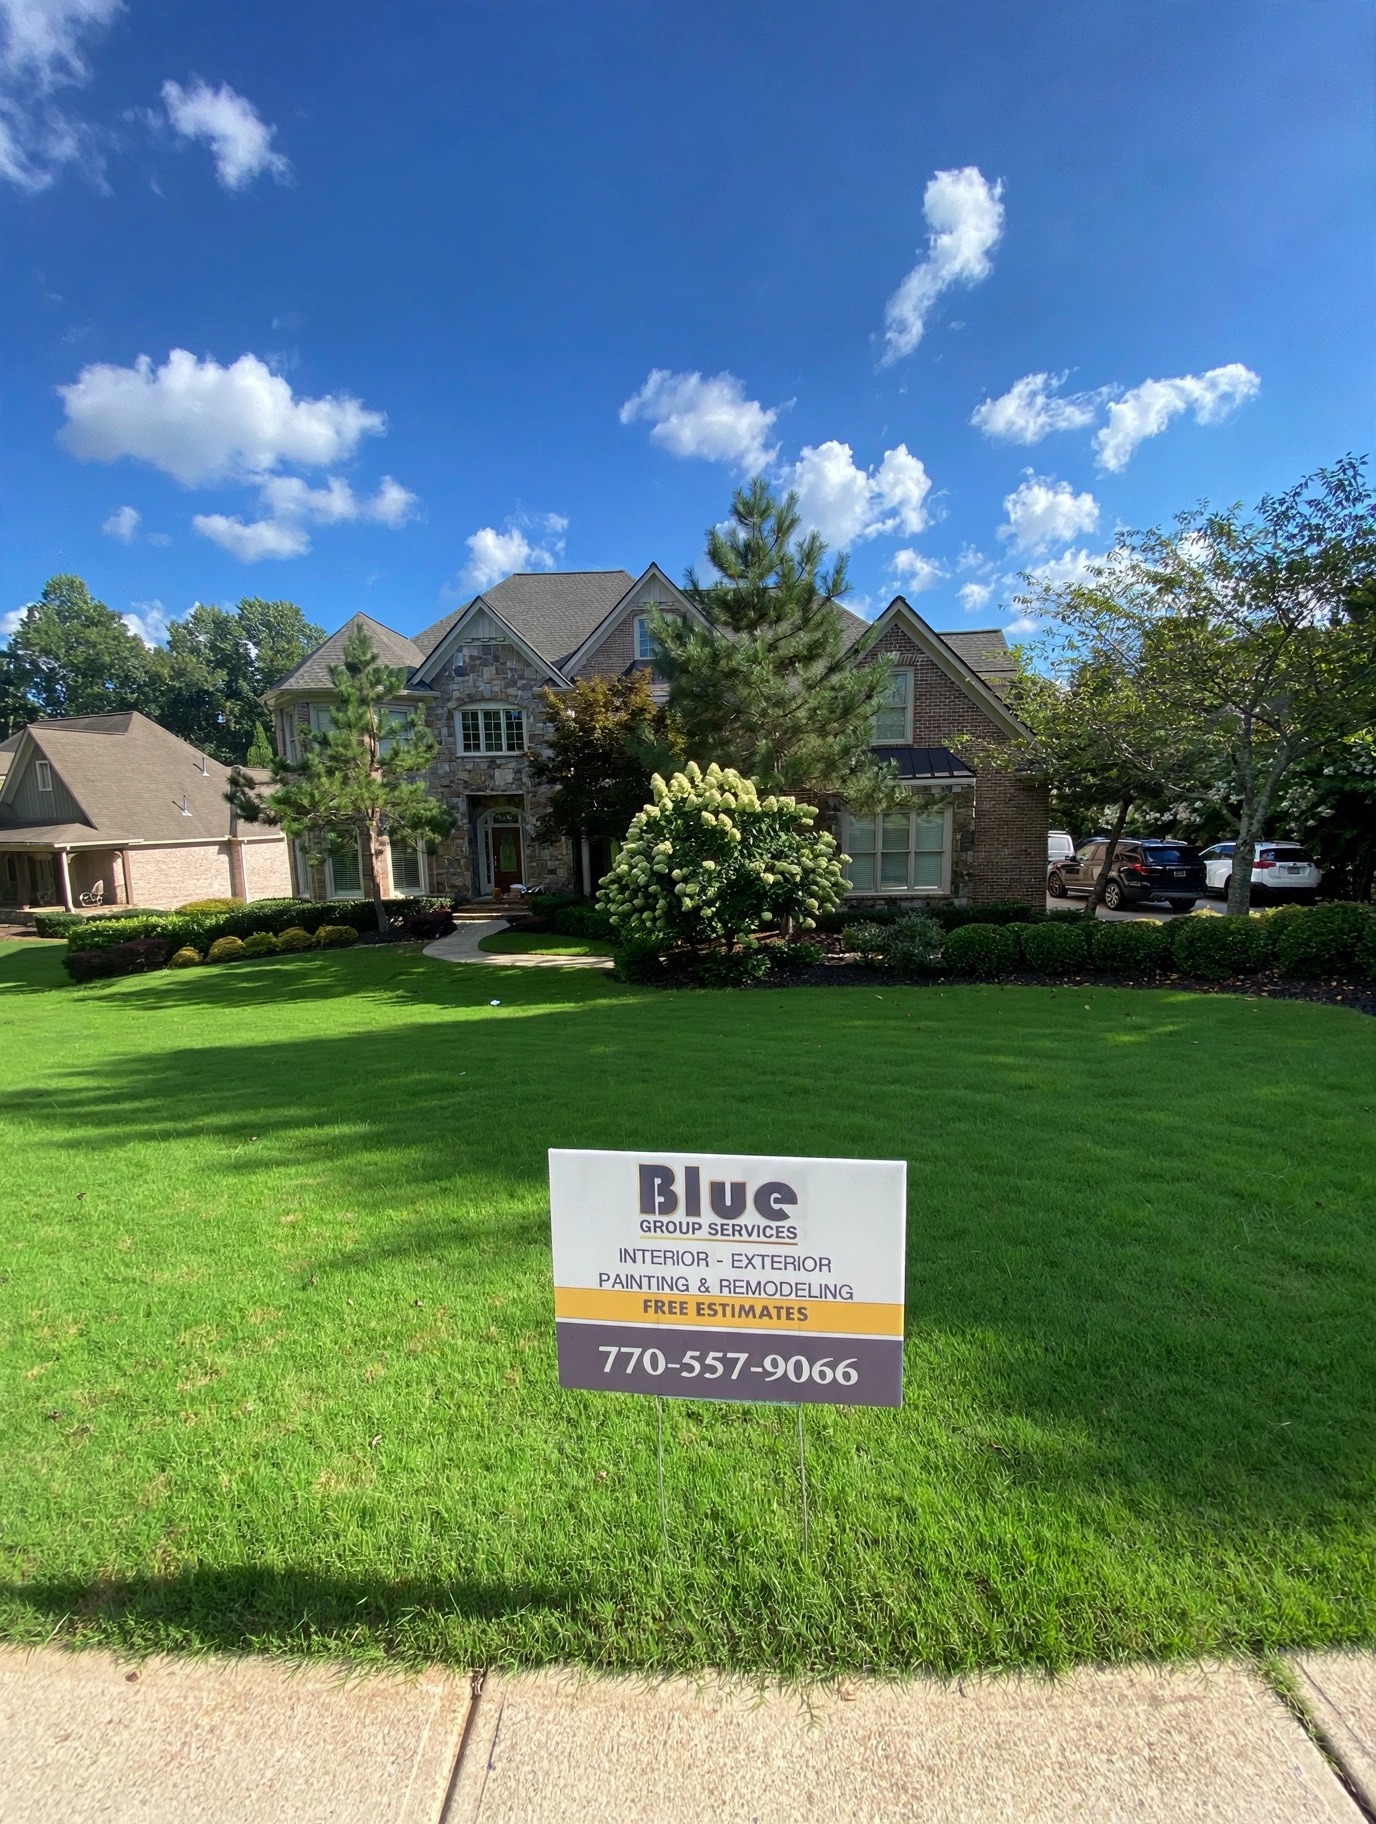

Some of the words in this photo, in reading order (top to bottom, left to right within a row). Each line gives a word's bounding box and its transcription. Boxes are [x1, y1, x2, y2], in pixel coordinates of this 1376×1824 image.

[636, 1163, 799, 1222] Blue
[639, 1219, 703, 1236] GROUP
[708, 1222, 798, 1240] SERVICES
[619, 1248, 709, 1268] INTERIOR
[731, 1253, 832, 1273] EXTERIOR
[599, 1272, 690, 1293] PAINTING
[697, 1278, 711, 1294] &
[719, 1279, 854, 1301] REMODELING
[643, 1299, 689, 1316] FREE
[695, 1301, 809, 1322] ESTIMATES
[598, 1345, 859, 1386] 770-557-9066
